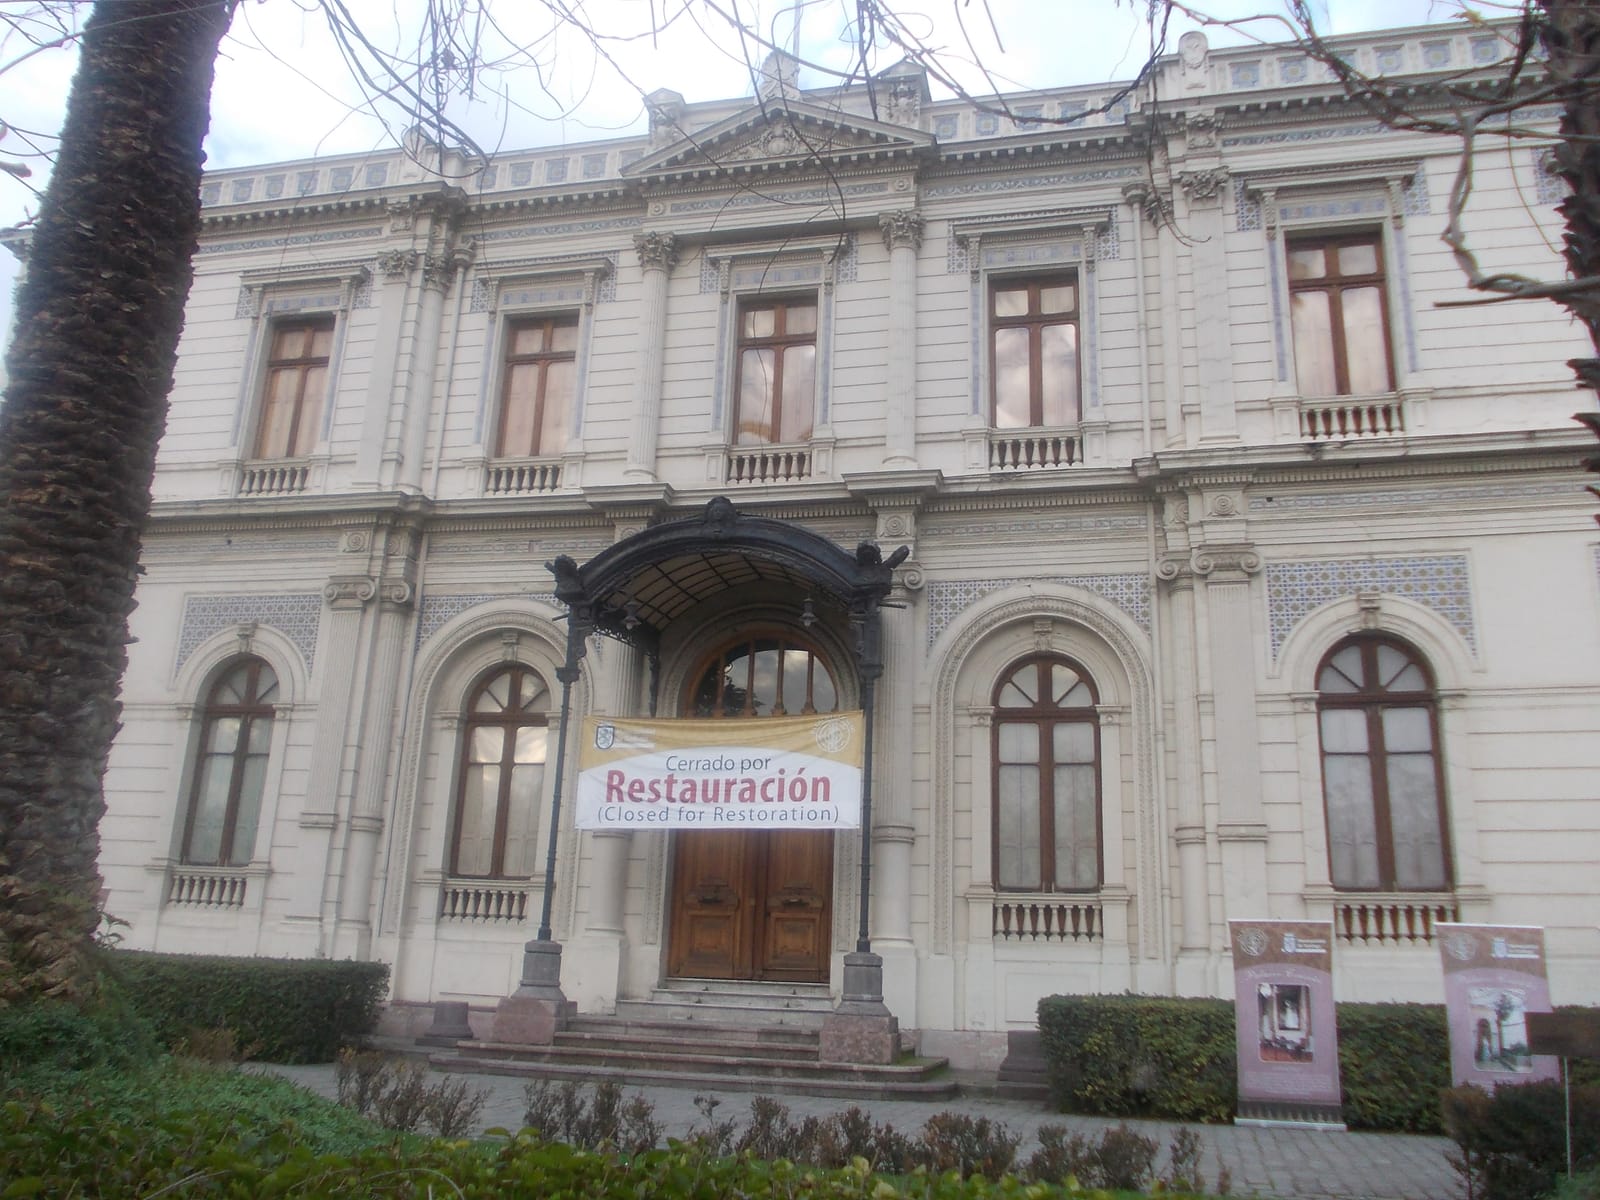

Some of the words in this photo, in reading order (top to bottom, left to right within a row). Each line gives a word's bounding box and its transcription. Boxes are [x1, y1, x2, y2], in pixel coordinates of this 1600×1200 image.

[666, 755, 735, 772] Cerrado
[740, 756, 771, 774] por
[605, 768, 831, 804] Restauración
[598, 806, 669, 823] (Closed
[678, 806, 705, 822] for
[713, 806, 839, 823] Restoration)
